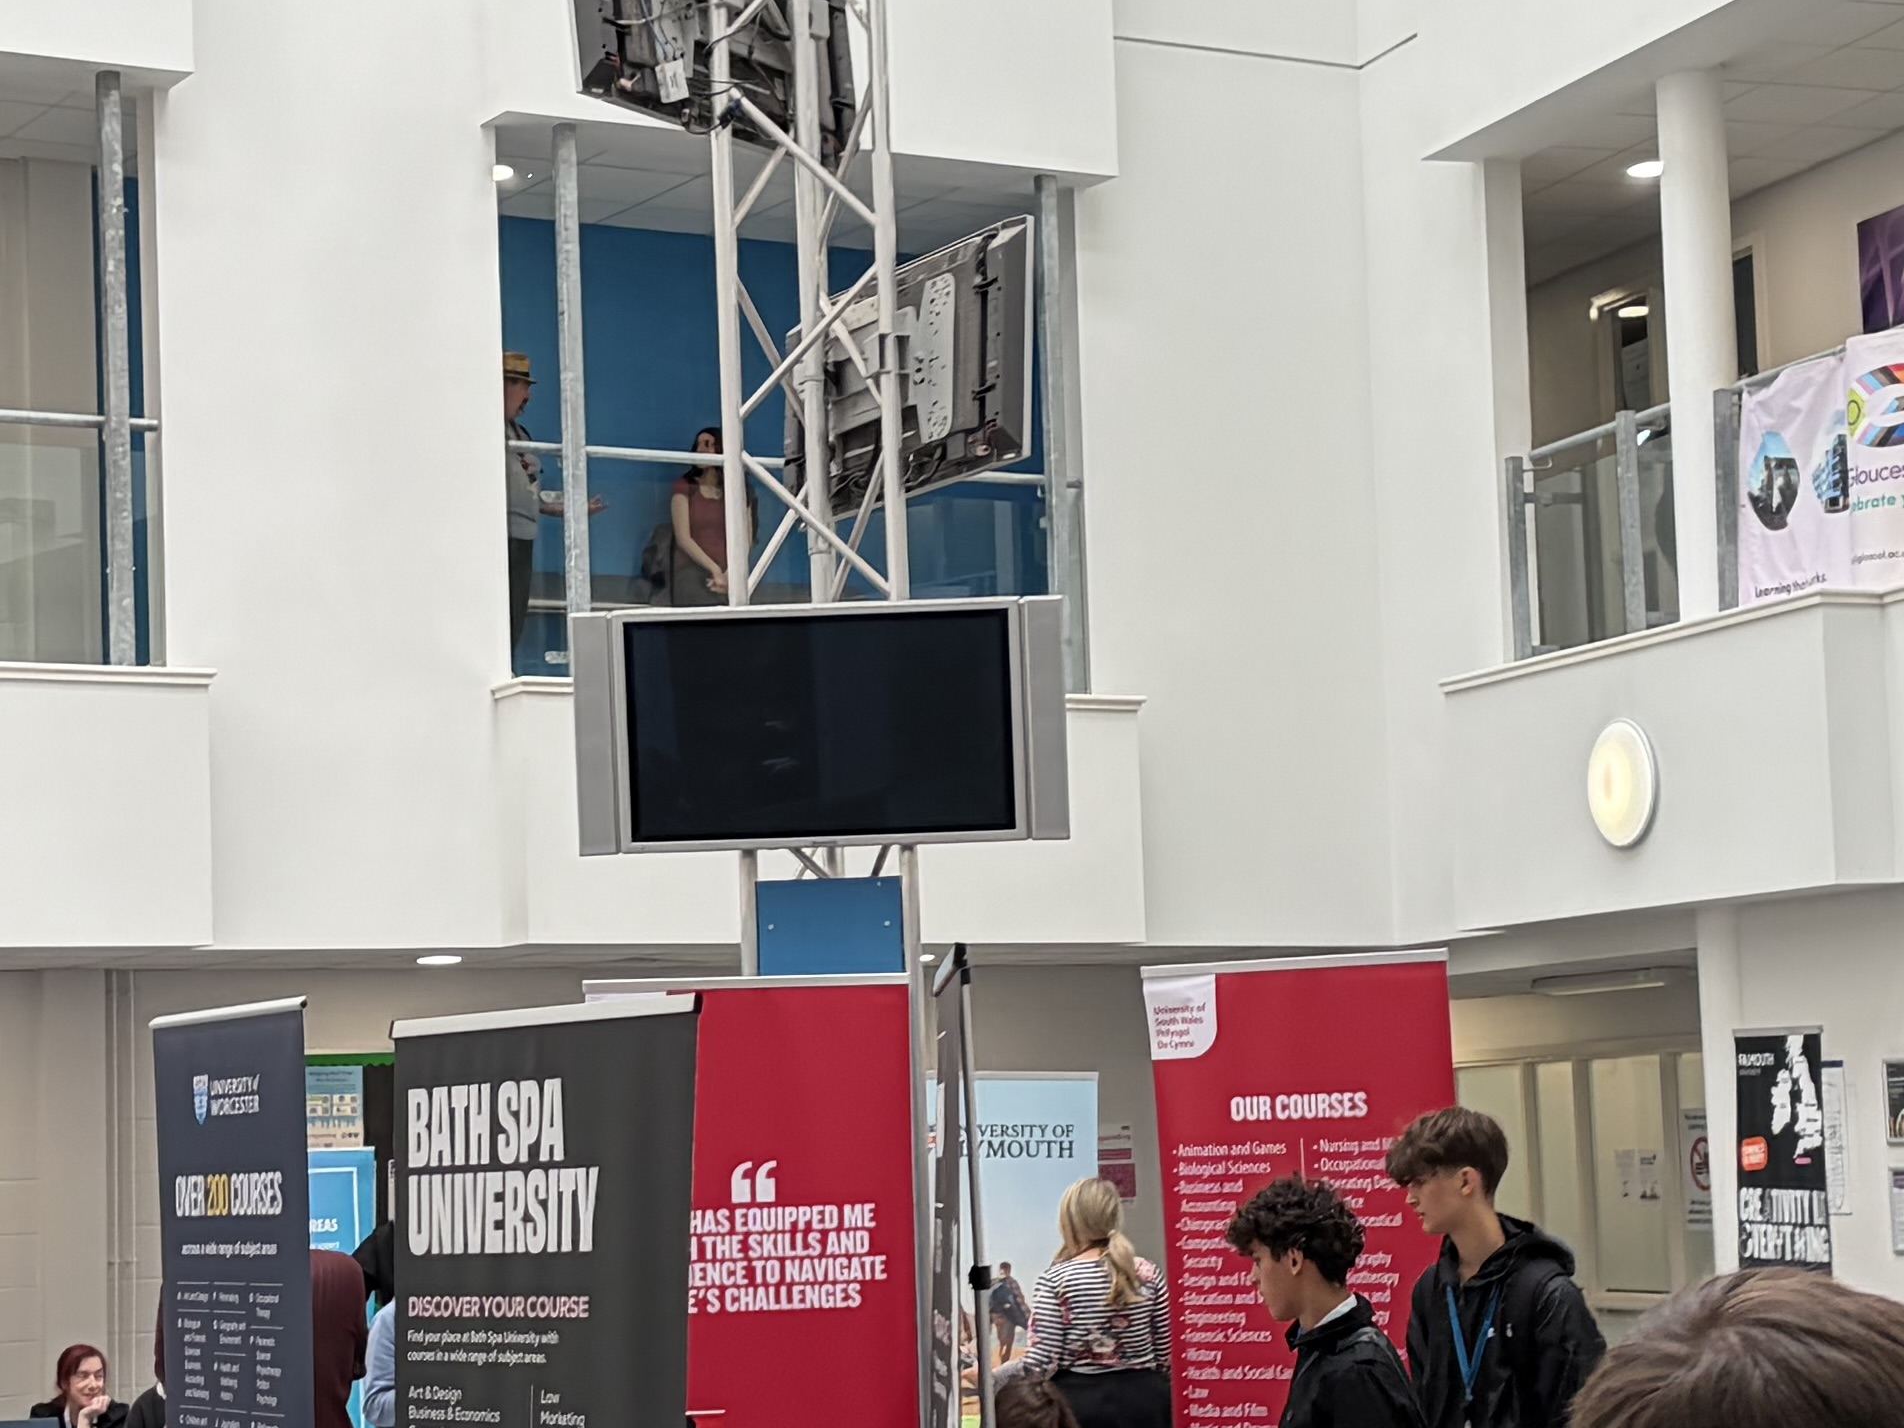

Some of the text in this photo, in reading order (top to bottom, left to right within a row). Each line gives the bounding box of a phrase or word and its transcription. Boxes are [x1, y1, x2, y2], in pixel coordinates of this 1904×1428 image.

[1231, 1091, 1368, 1122] OUR COURSES
[408, 1077, 564, 1168] BATH SPA
[1052, 1124, 1074, 1138] OF
[1178, 1141, 1286, 1157] Animation and Games
[1320, 1139, 1359, 1155] Nursing
[1179, 1160, 1271, 1179] Biological Sciences
[176, 1171, 282, 1217] OVER 200 COURSES
[408, 1166, 599, 1256] UNIVERSITY
[690, 1203, 876, 1234] HAS EQUIPPED ME
[702, 1230, 870, 1260] THE SKILLS AND
[752, 1255, 888, 1285] TO NAVIGATE
[408, 1295, 590, 1318] DISCOVER YOUR COURSE
[725, 1283, 862, 1313] CHALLENGES
[503, 1330, 541, 1347] University
[407, 1350, 436, 1362] courses
[497, 1351, 524, 1366] subject
[409, 1386, 424, 1400] Art
[432, 1387, 462, 1405] Design
[408, 1406, 445, 1420] Business
[455, 1407, 501, 1423] Economics
